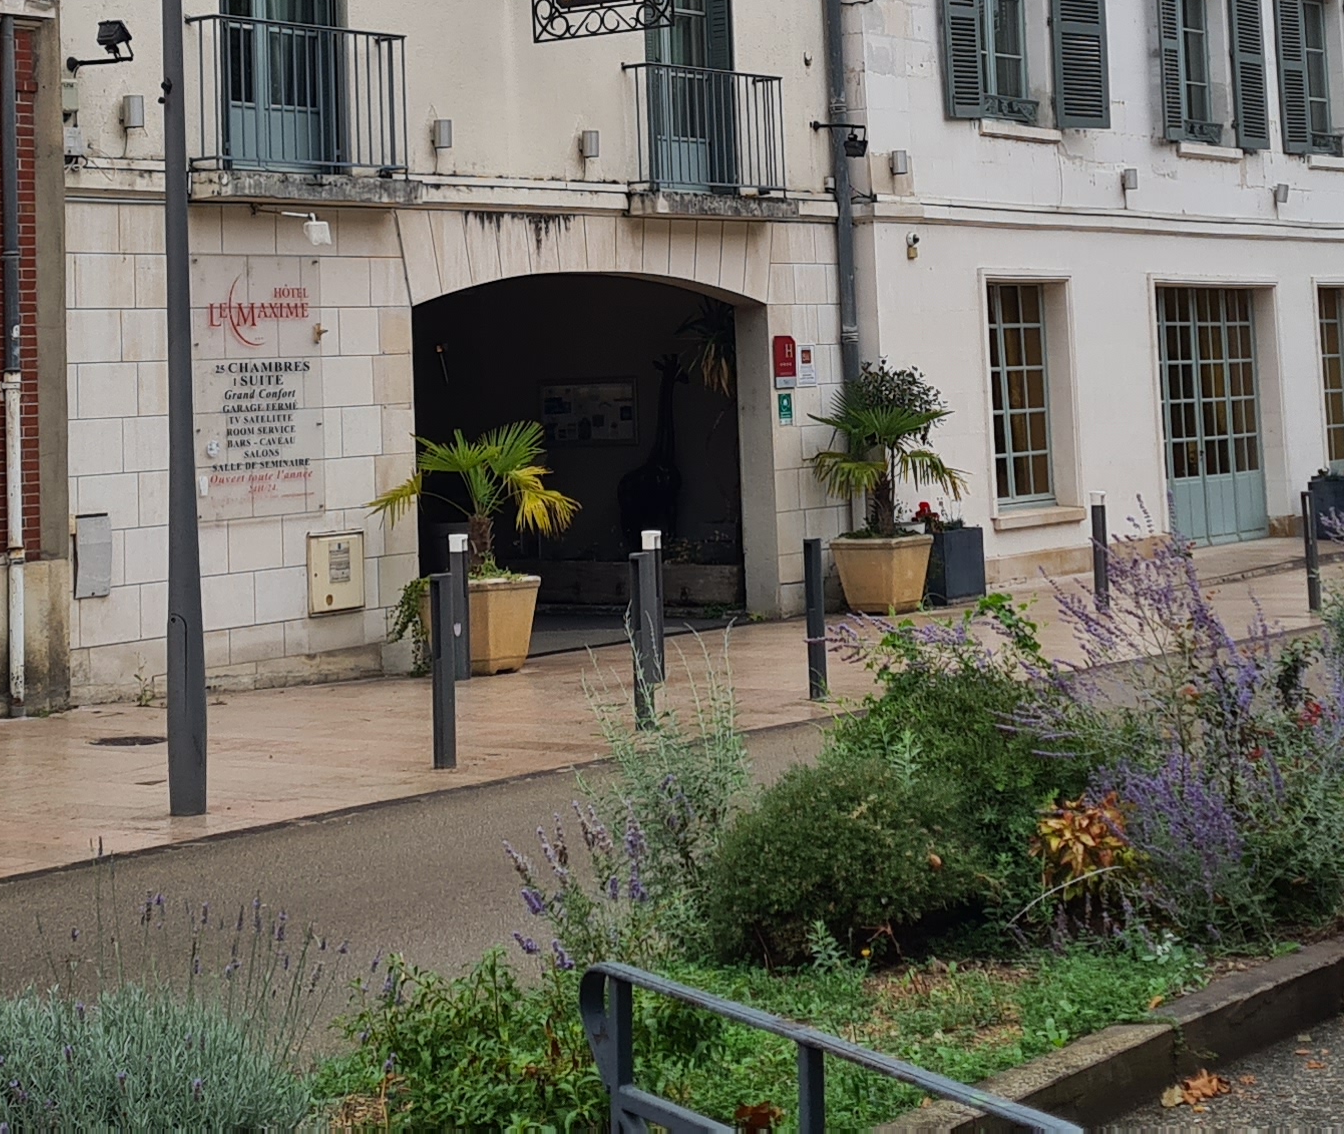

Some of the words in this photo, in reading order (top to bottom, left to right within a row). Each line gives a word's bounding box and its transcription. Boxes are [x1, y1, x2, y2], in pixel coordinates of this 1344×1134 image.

[209, 302, 228, 327] LE
[236, 302, 309, 327] MAXIME
[785, 344, 793, 358] H
[228, 361, 310, 373] CHAMBRES
[240, 375, 284, 386] SUITE
[224, 389, 256, 400] Grand
[258, 388, 296, 400] Confort
[222, 404, 264, 413] GARAGE
[229, 416, 241, 424] TV
[227, 428, 255, 436] ROOM
[257, 425, 296, 434] SERVICE
[227, 439, 251, 448] BARS
[259, 437, 296, 446] CAVEAU
[244, 449, 280, 458] SALONS
[212, 463, 243, 472] SALLE
[245, 461, 257, 470] DE
[210, 474, 245, 484] Ouvert
